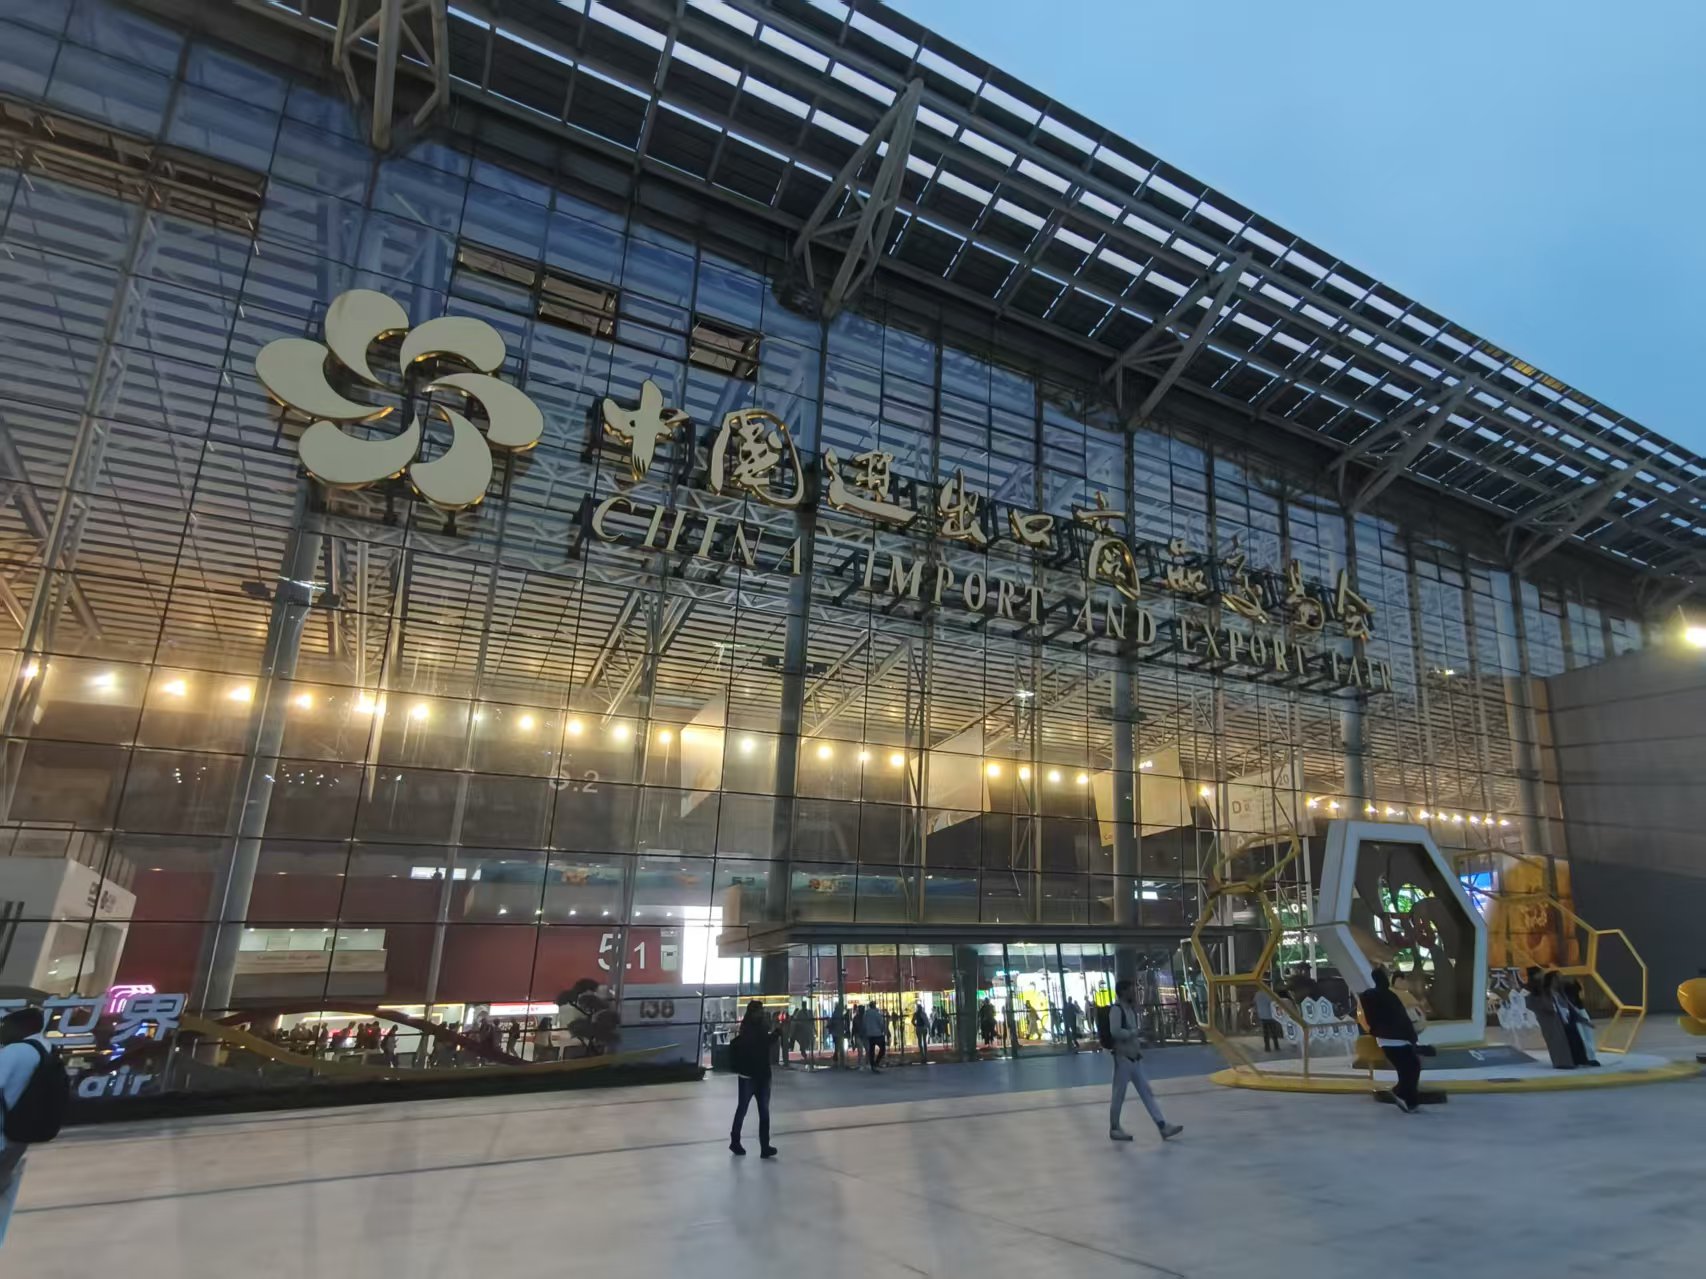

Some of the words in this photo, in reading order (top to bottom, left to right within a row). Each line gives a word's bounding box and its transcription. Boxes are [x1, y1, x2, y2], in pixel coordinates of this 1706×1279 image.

[591, 497, 801, 575] CHINA
[862, 549, 1044, 625] IMPORT
[1073, 600, 1156, 647] AND
[1180, 617, 1306, 674] EXPORT
[1329, 648, 1394, 691] FAIR
[598, 933, 645, 971] 5.1
